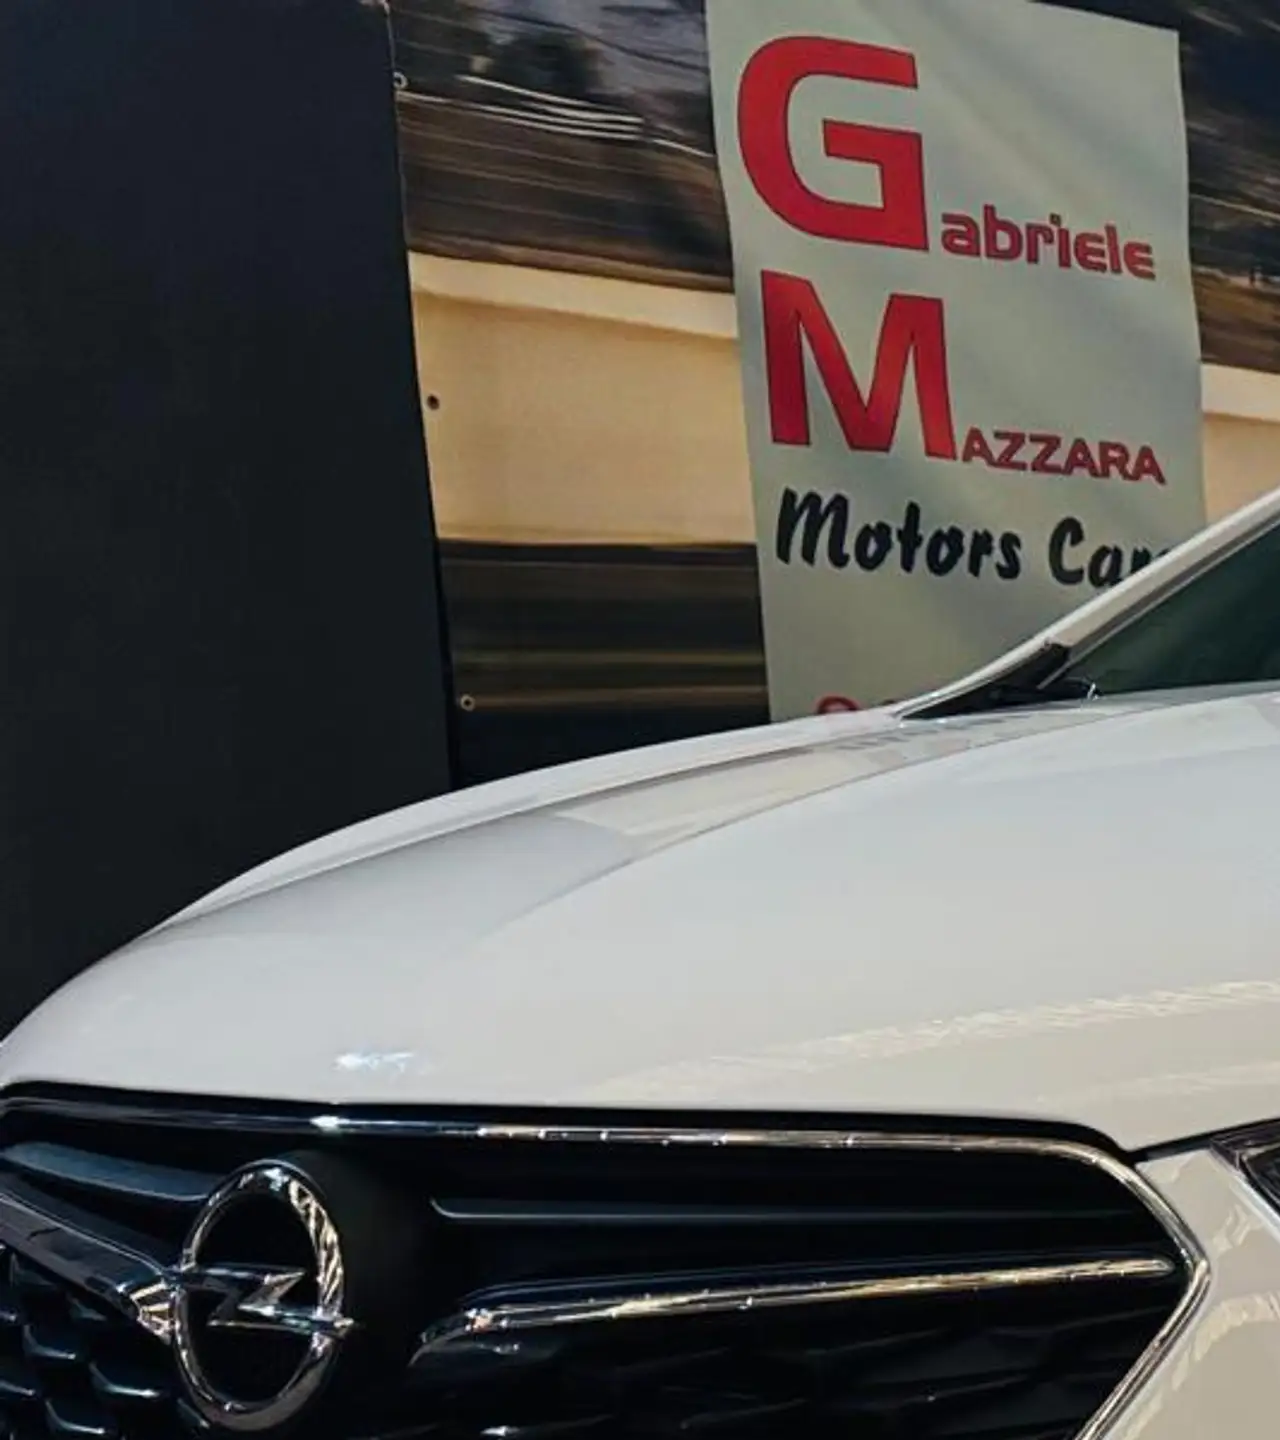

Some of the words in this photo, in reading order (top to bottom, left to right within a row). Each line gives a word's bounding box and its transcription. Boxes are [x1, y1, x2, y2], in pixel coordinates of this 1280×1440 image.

[737, 35, 1156, 280] Gabriele
[775, 487, 1022, 580] Motors
[1048, 516, 1172, 588] Car
